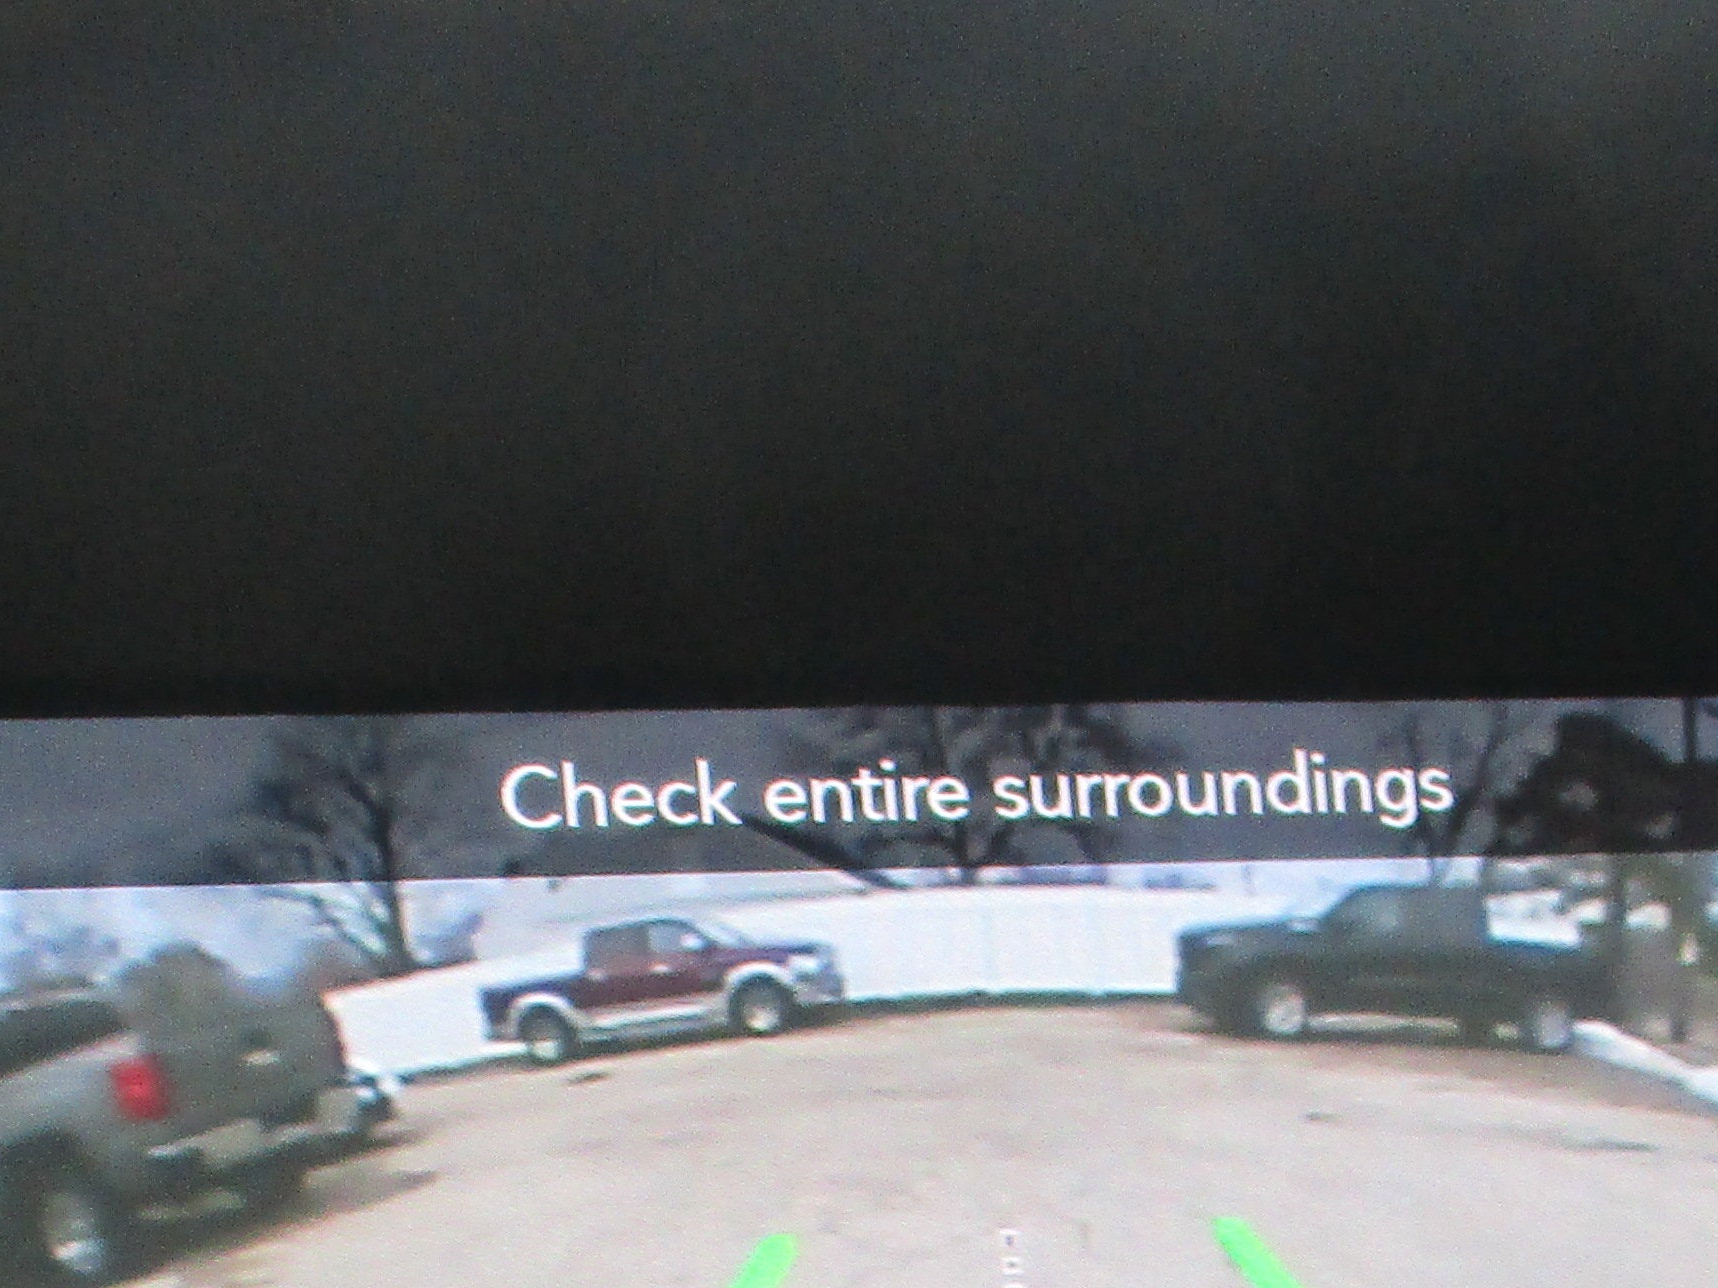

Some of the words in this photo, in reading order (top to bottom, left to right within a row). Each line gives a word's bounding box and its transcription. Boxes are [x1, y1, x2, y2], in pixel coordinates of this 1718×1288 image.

[499, 757, 742, 830] Check
[762, 758, 971, 824] entire
[992, 748, 1456, 829] surroundings
